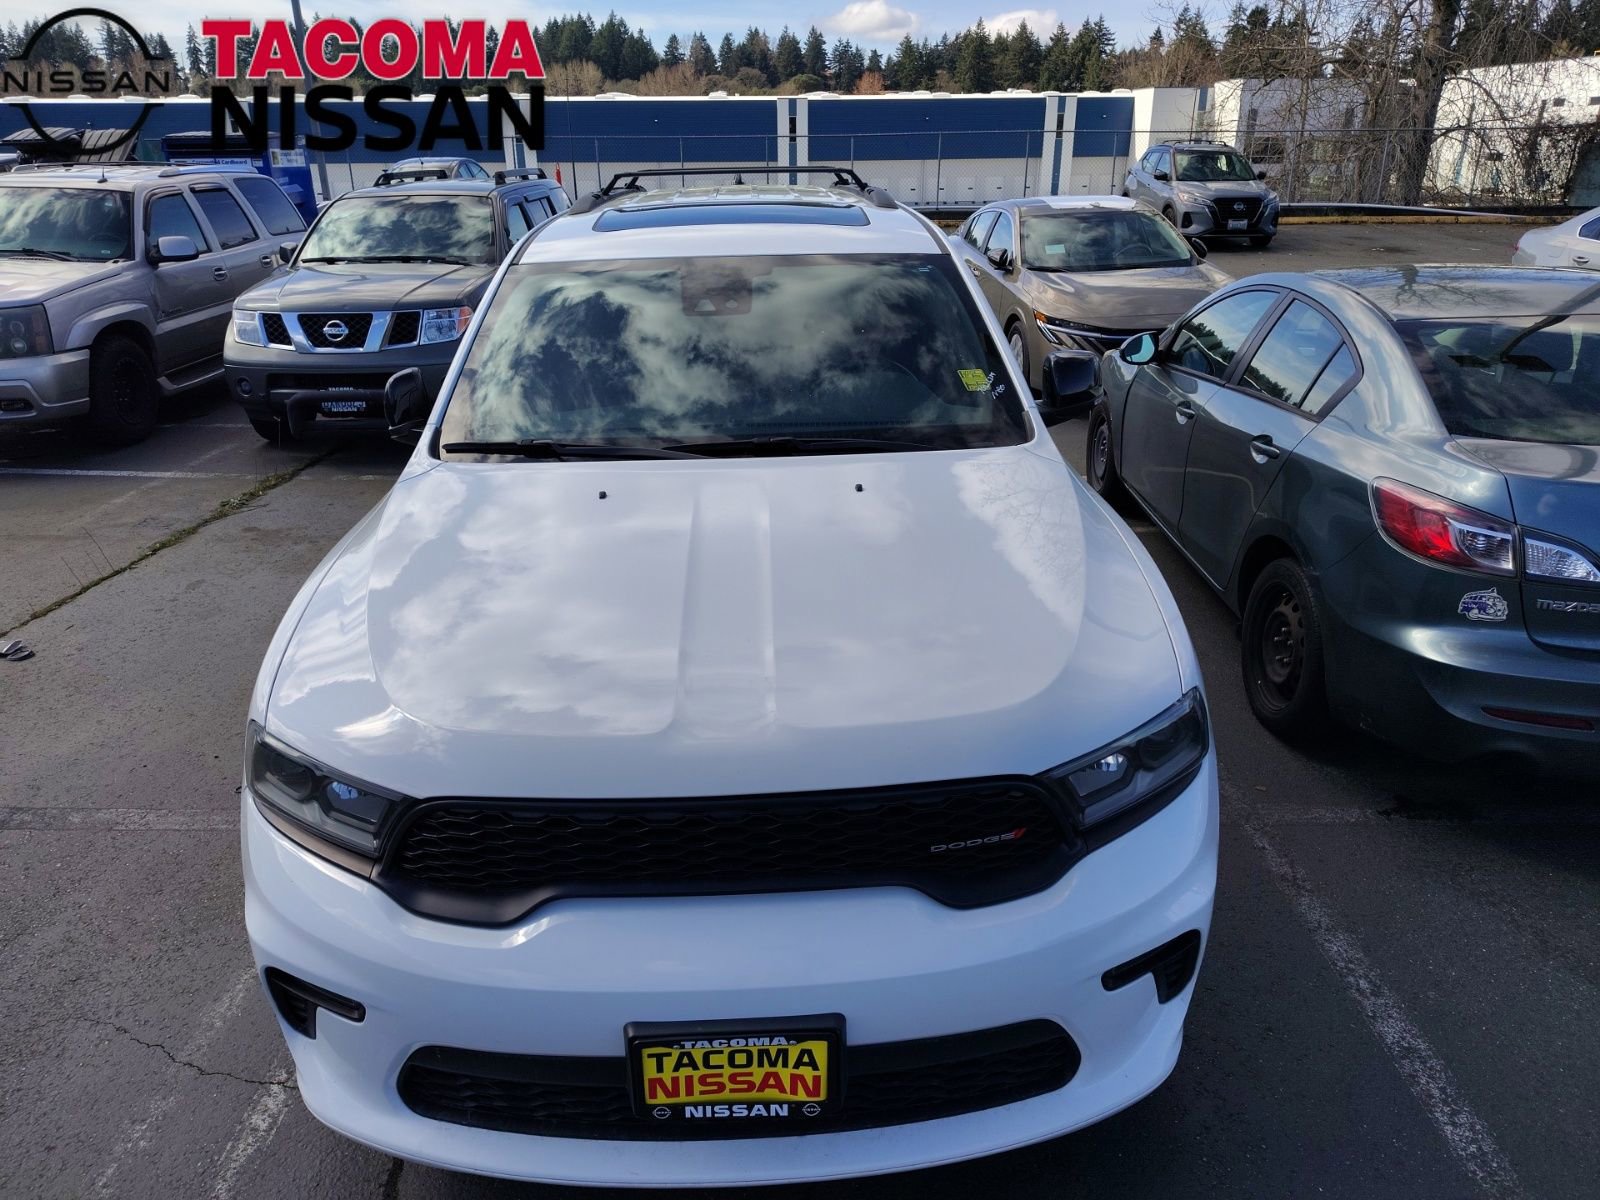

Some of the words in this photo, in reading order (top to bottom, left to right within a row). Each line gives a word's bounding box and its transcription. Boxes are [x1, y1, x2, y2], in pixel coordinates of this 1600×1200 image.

[1536, 598, 1600, 613] mazda
[930, 832, 1015, 852] DODGE
[681, 1036, 786, 1049] TACOMA
[647, 1048, 820, 1073] TACOMA
[648, 1072, 821, 1099] NISSAN
[685, 1104, 788, 1118] NISSAN
